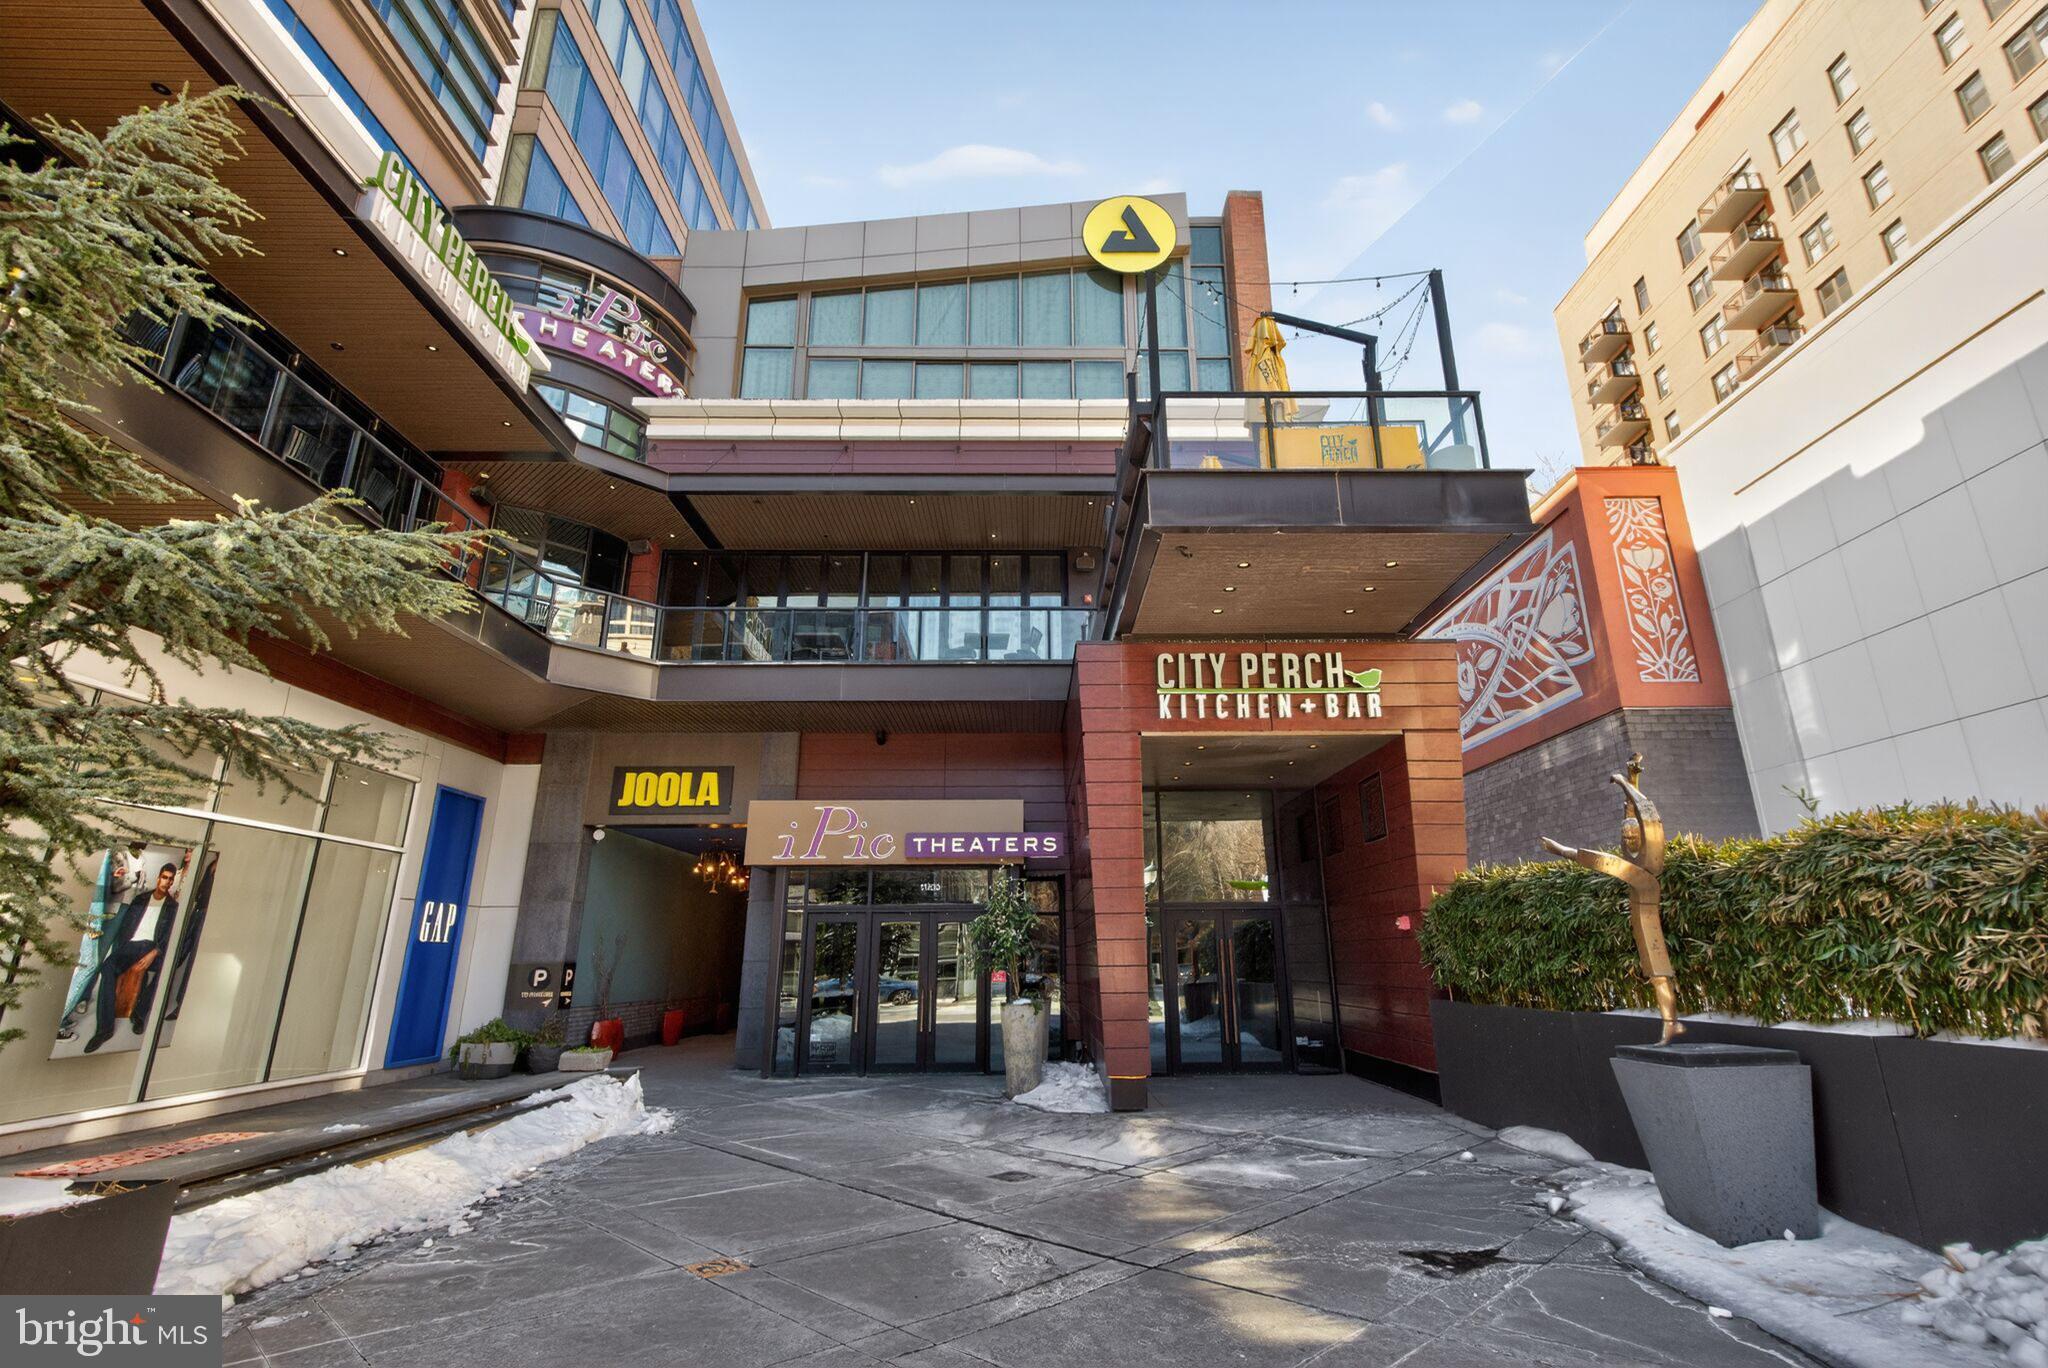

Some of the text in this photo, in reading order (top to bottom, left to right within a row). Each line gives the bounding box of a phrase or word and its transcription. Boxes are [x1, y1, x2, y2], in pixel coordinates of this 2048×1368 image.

[377, 151, 514, 337] CITY PERCH
[377, 197, 479, 328] KITCHEN
[496, 332, 529, 391] BAR
[549, 284, 668, 363] iPic
[1157, 652, 1345, 689] CITY PERCH
[1158, 693, 1382, 719] KITCHEN + BAR
[617, 772, 720, 807] JOOLA
[772, 806, 1058, 860] iPic THEATERS
[419, 901, 457, 943] GAP
[533, 969, 548, 987] P
[564, 969, 574, 986] P
